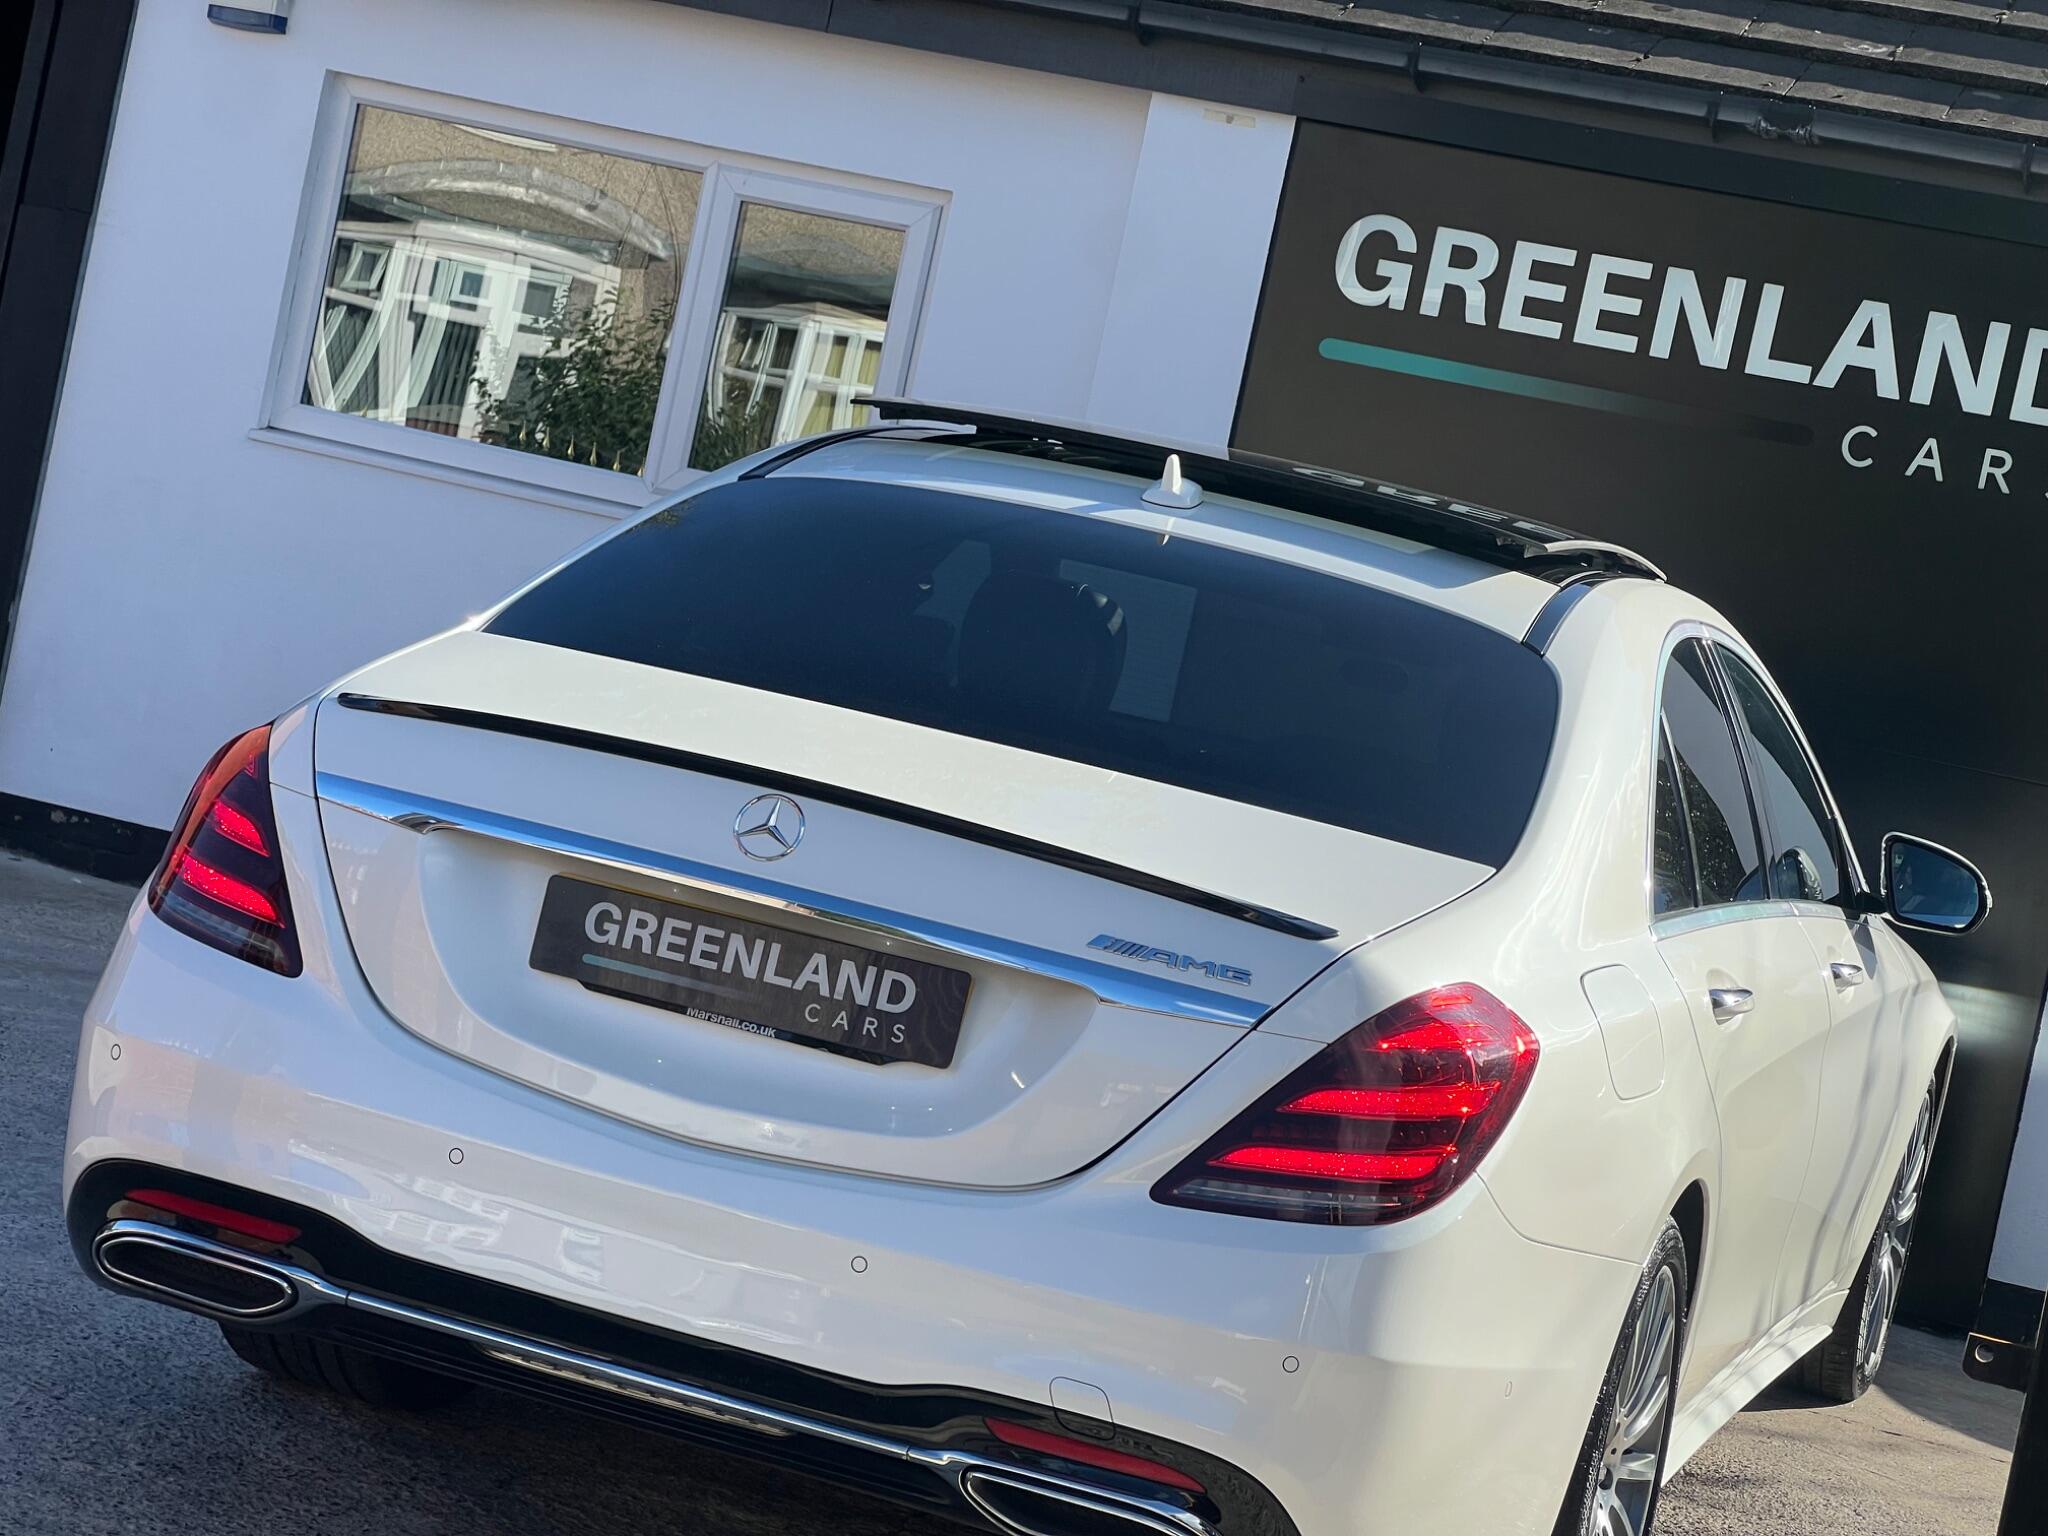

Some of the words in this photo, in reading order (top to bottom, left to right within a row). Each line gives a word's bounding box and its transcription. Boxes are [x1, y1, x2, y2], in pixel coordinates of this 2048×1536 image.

[1841, 425, 2048, 499] CAR
[584, 902, 917, 1014] GREENLAND
[1140, 947, 1252, 986] AMG
[804, 1003, 906, 1043] CARS
